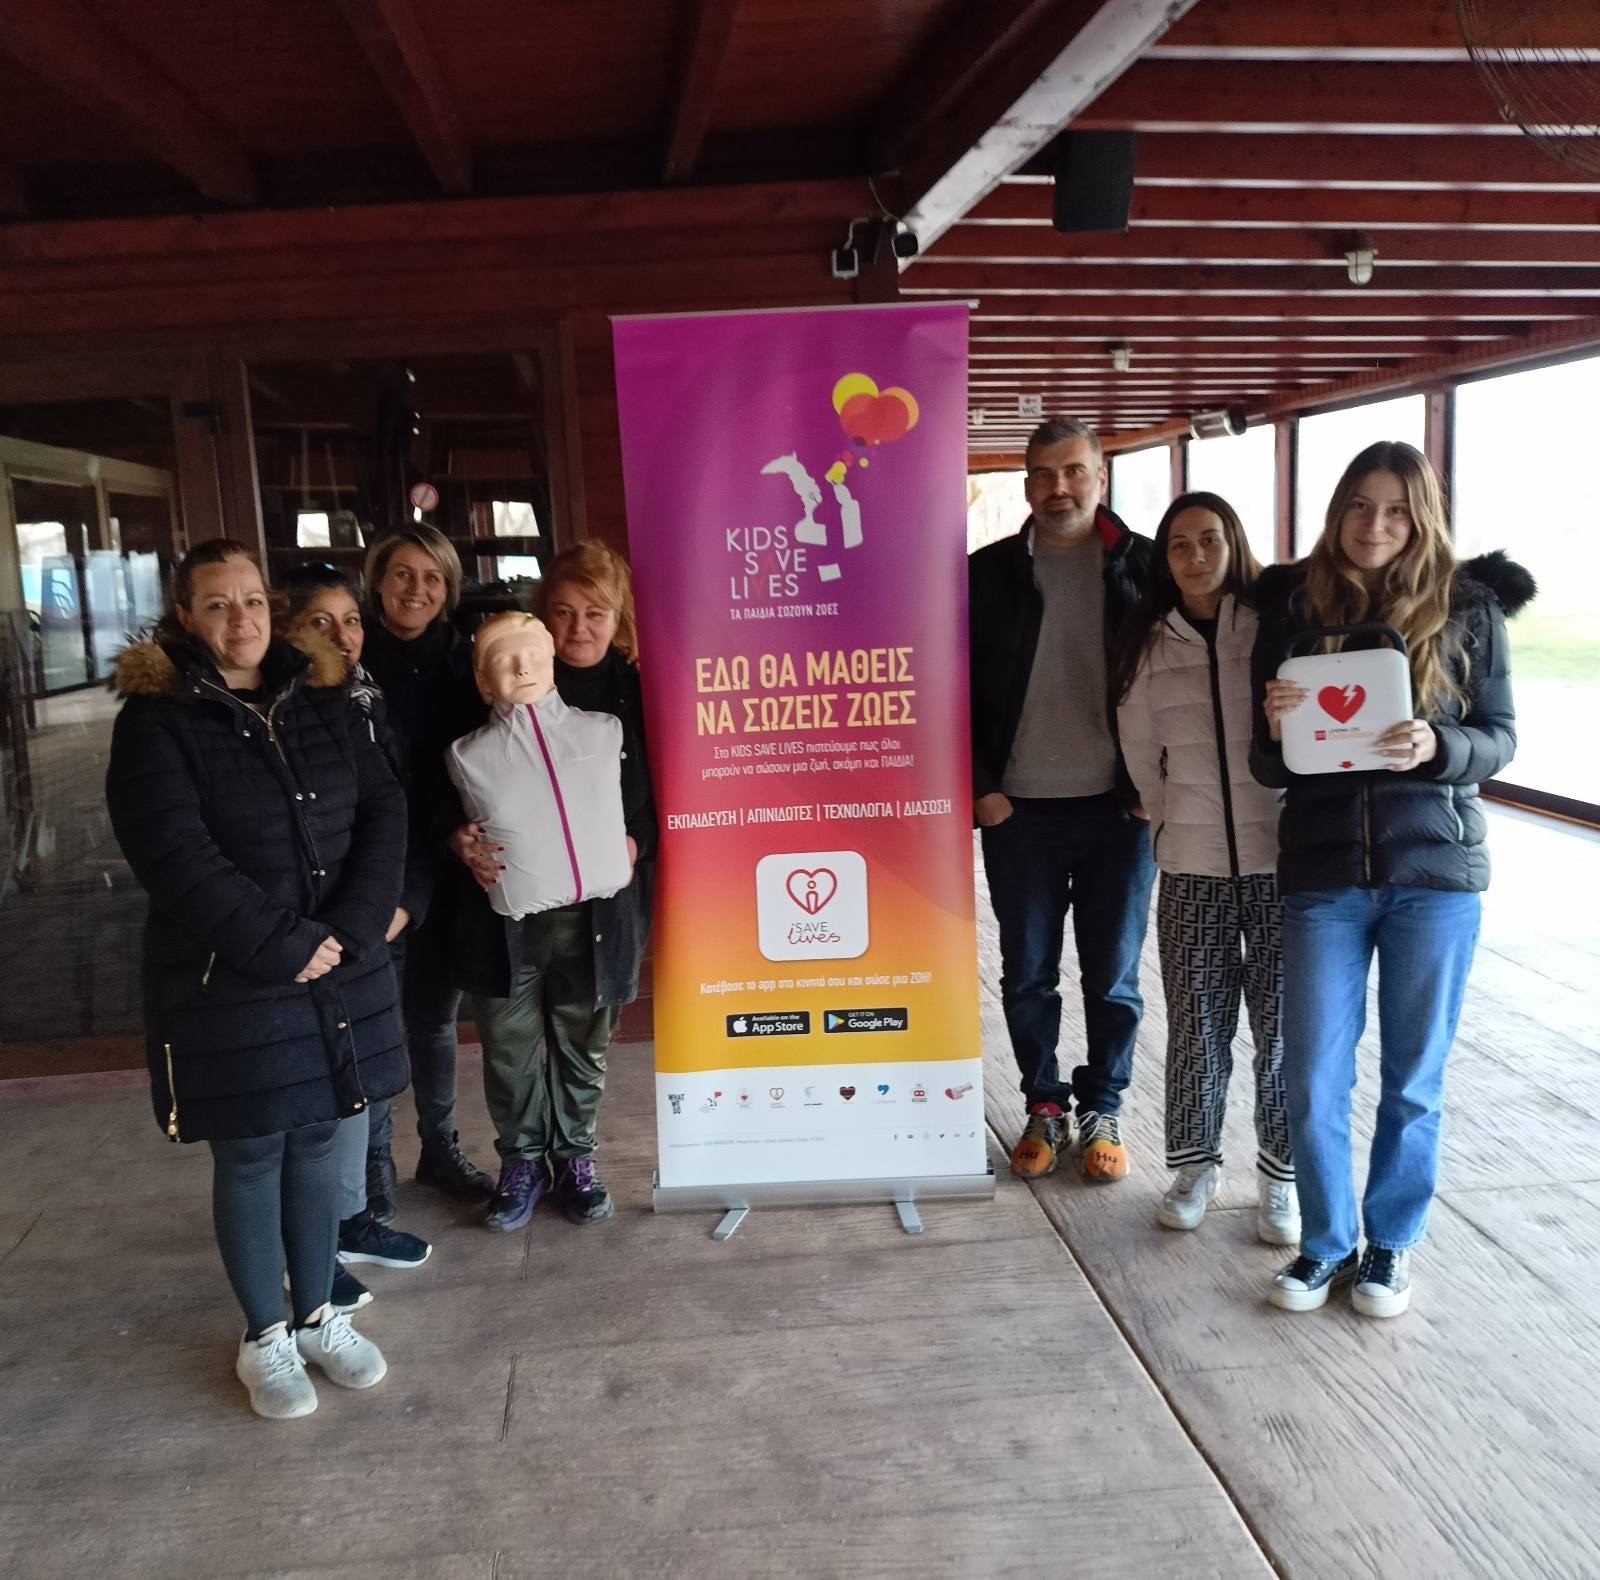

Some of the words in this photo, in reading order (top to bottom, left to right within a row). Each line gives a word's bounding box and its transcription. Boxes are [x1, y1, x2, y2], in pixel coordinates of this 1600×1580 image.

[726, 525, 788, 552] KIDS
[744, 548, 807, 575] SAVE
[730, 573, 800, 600] LIVES
[730, 608, 742, 620] ΤΑ
[744, 606, 775, 619] ΠΑΙΔΙΑ
[777, 604, 813, 618] ΣΩΖΟΥΝ
[815, 602, 839, 617] ΖΩΕΣ
[696, 656, 750, 693] ΕΔΩ
[759, 653, 798, 689] ΘΑ
[806, 647, 915, 687] ΜΑΘΕΙΣ
[696, 700, 736, 736] ΝΑ
[743, 694, 839, 733] ΣΩΖΕΙΣ
[847, 690, 917, 728] ΖΩΕΣ
[731, 744, 752, 758] KIDS
[754, 742, 777, 757] SAVE
[779, 741, 804, 755] LIVES
[667, 810, 736, 830] ΕΚΠΑΙΔΕΥΣΗ
[747, 805, 813, 824] ΑΠΙΝΙΔΩΤΕΣ
[823, 802, 894, 820] ΤΕΧΝΟΛΟΓΙΑ
[903, 799, 951, 817] ΔΙΑΣΩΣΗ
[758, 980, 776, 992] app
[752, 1022, 774, 1035] App
[775, 1021, 804, 1032] Store
[847, 1018, 882, 1030] Google
[883, 1017, 903, 1028] Play
